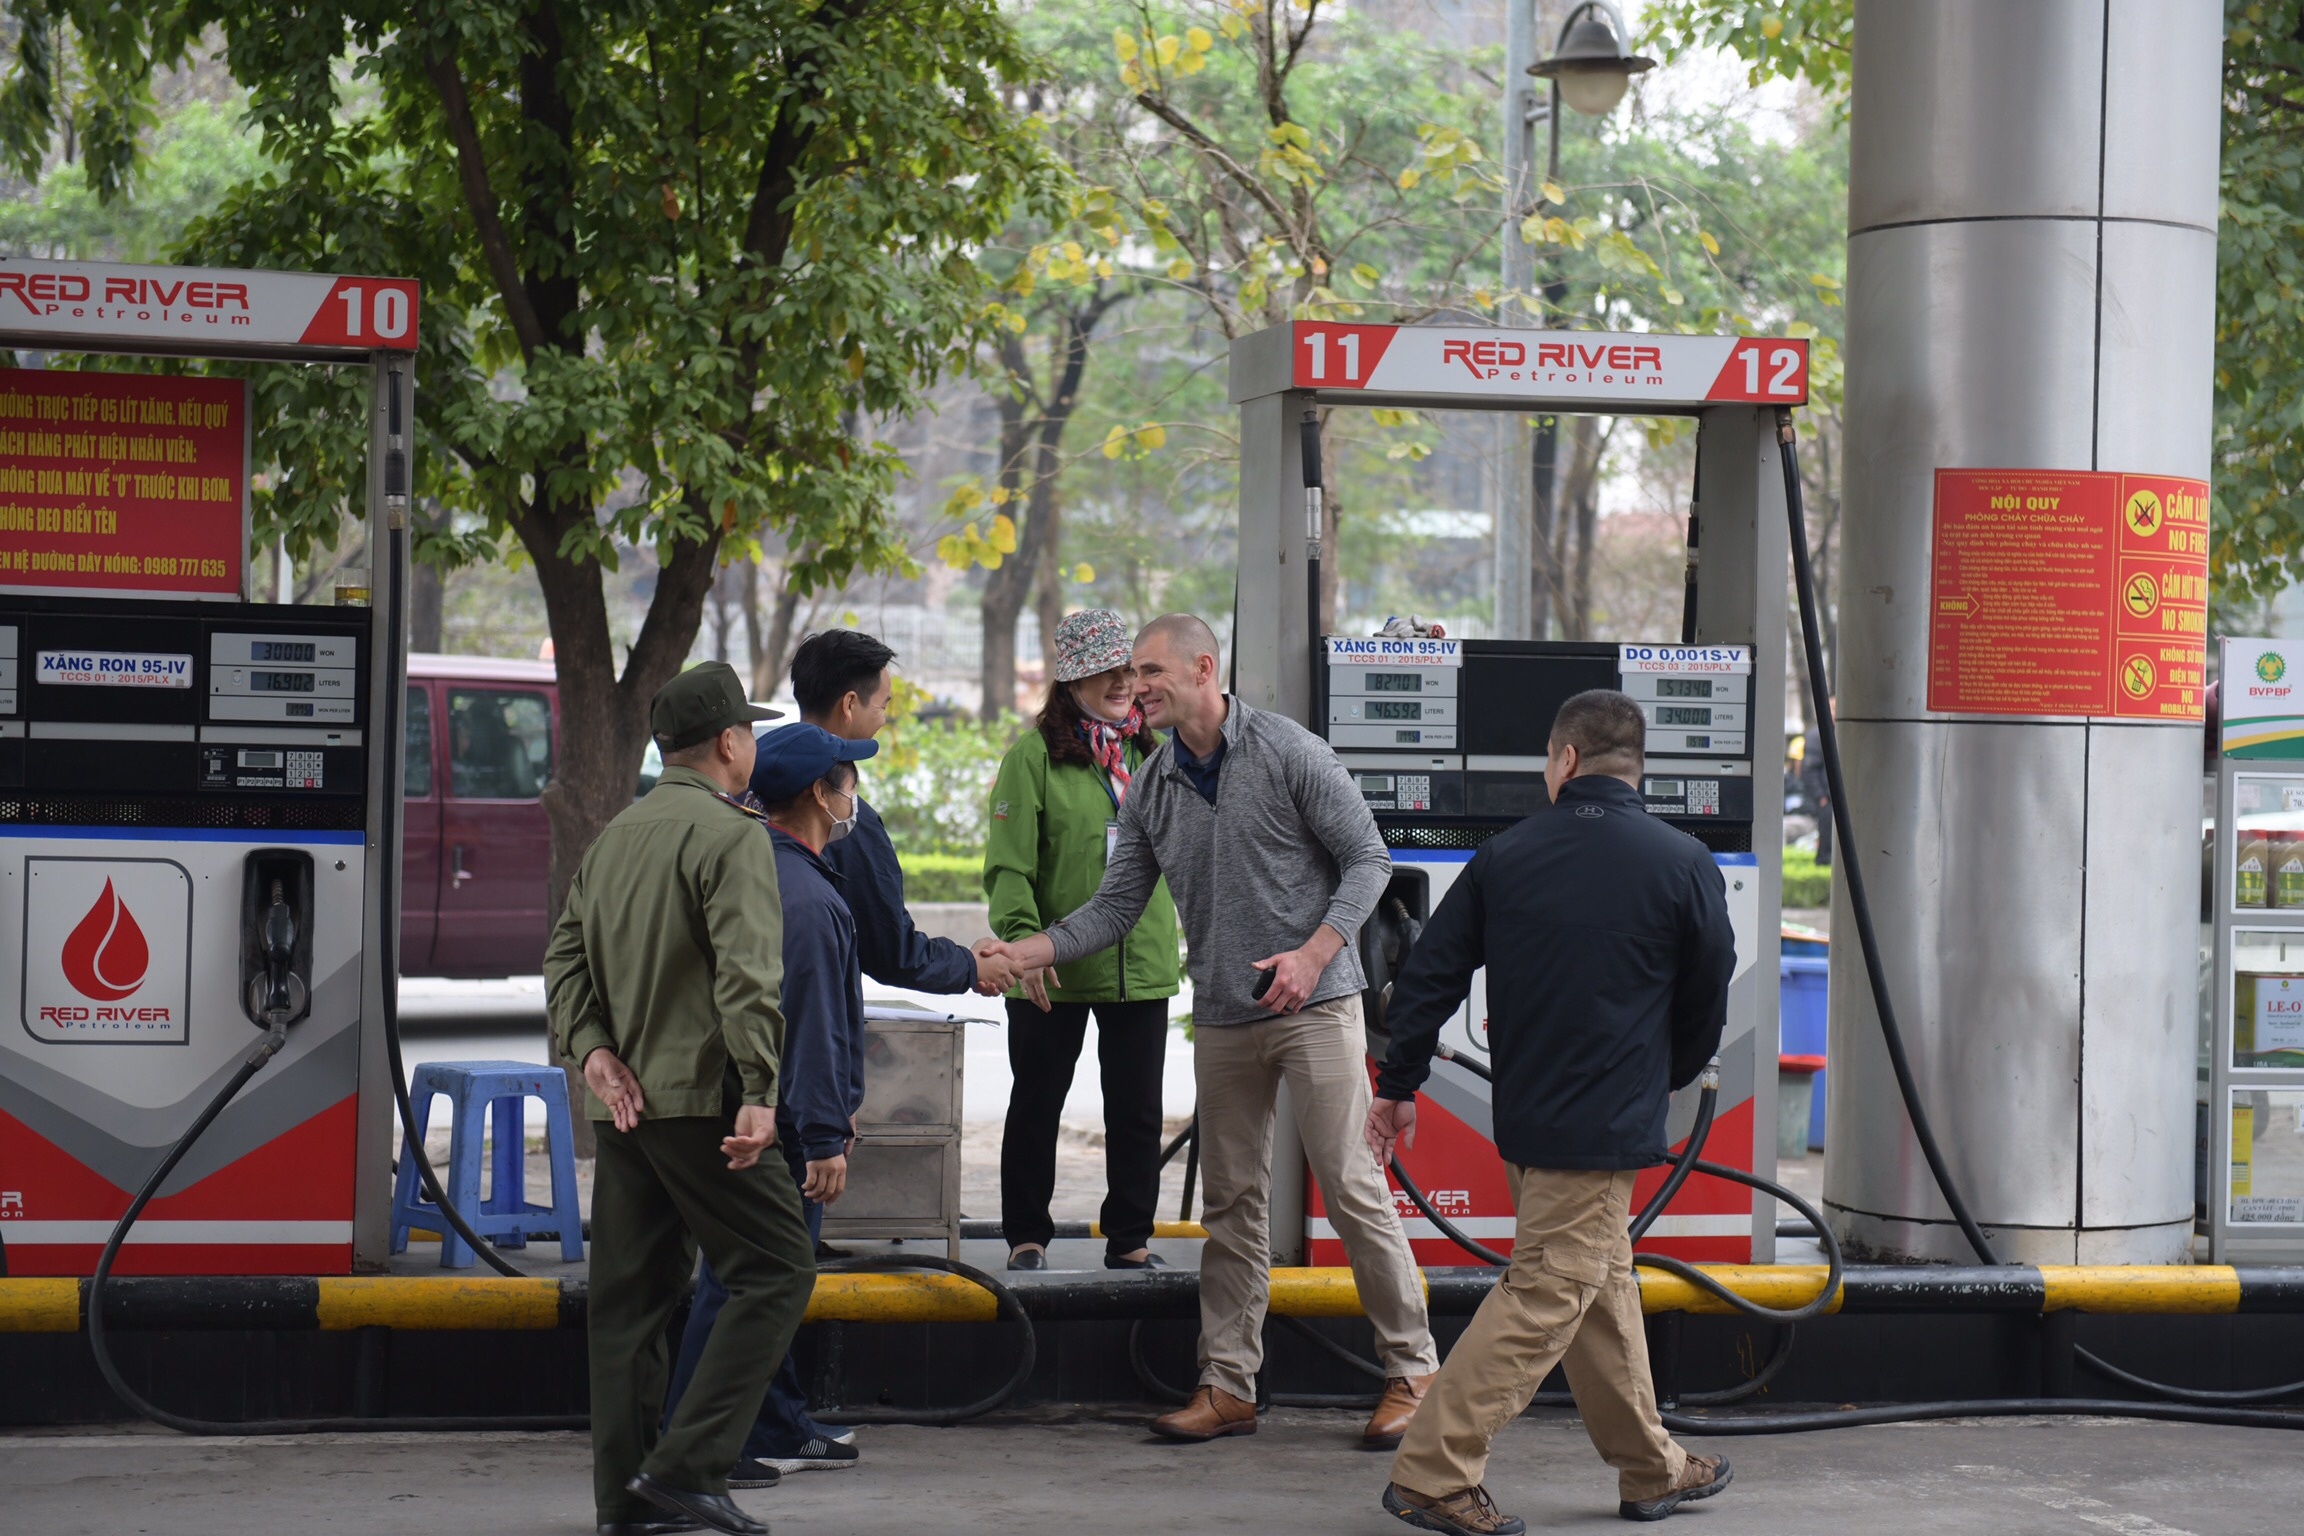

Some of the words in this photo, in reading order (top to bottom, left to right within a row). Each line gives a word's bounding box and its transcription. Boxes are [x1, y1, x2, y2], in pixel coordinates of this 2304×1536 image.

[0, 272, 90, 316] RED
[105, 277, 249, 310] RIVER
[45, 303, 250, 325] Petroleum
[338, 286, 408, 338] 10
[1303, 332, 1360, 381] 11
[1443, 339, 1526, 379] RED
[1538, 343, 1662, 371] RIVER
[1488, 369, 1663, 385] Petroleum
[1738, 347, 1800, 395] 12
[36, 394, 69, 425] TRỰC
[72, 393, 98, 422] TIẾP
[101, 398, 117, 422] 05
[120, 395, 138, 423] LÍT
[140, 397, 176, 425] XĂNG.
[179, 397, 201, 427] NẾU
[204, 400, 229, 430] QUÝ
[28, 428, 62, 457] HÀNG
[65, 430, 96, 459] PHÁT
[99, 432, 127, 465] HIỆN
[130, 434, 163, 462] NHÂN
[166, 435, 197, 463] VIÊN:
[37, 468, 63, 494] ĐƯA
[66, 467, 92, 496] MÁY
[95, 468, 110, 497] VỀ
[134, 470, 175, 499] TRƯỚC
[178, 477, 198, 501] KHI
[201, 477, 232, 502] BƠM.
[1991, 494, 2020, 512] NỘI
[2027, 497, 2060, 511] QUY
[2166, 486, 2193, 520] CẤM
[37, 507, 60, 533] ĐEO
[64, 502, 91, 534] BIỂN
[95, 506, 116, 535] TÊN
[1965, 512, 1998, 521] PHÒNG
[2001, 512, 2028, 522] CHÁY
[2059, 512, 2085, 523] CHÁY
[2169, 530, 2187, 552] NO
[2190, 532, 2206, 554] FIRE
[14, 549, 28, 573] HỆ
[32, 549, 74, 572] ĐƯỜNG
[78, 551, 101, 572] DÂY
[104, 553, 141, 574] NÓNG:
[144, 556, 177, 576] 0988
[180, 558, 198, 576] 777
[201, 559, 225, 577] 635
[2162, 565, 2180, 599] CẤM
[1940, 600, 1968, 611] KHÔNG
[2162, 609, 2176, 631] NO
[263, 643, 313, 661] 30000
[1334, 638, 1376, 653] XĂNG
[1382, 641, 1413, 654] RON
[1419, 642, 1456, 654] 95-IV
[1626, 648, 1652, 660] DO
[2160, 646, 2185, 662] KHÔNG
[43, 653, 93, 671] XĂNG
[100, 658, 136, 672] RON
[142, 659, 186, 674] 95-IV
[1348, 655, 1375, 663] TCCS
[1378, 655, 1388, 663] 01
[1398, 656, 1442, 664] 2015/PLX
[1639, 662, 1665, 670] TCCS
[1668, 663, 1679, 671] 03
[1688, 663, 1731, 671] 2015/PLX
[60, 672, 91, 682] TCCS
[95, 673, 106, 682] 01
[118, 674, 169, 684] 2015/PLX
[2182, 690, 2193, 704] NO
[2249, 687, 2291, 696] BVPBP
[2160, 703, 2186, 714] MOBILE
[2267, 1001, 2301, 1012] LE-O
[40, 1007, 89, 1028] RED
[96, 1008, 170, 1021] RIVER
[66, 1021, 170, 1029] Petroleum
[1393, 1190, 1470, 1206] RVER
